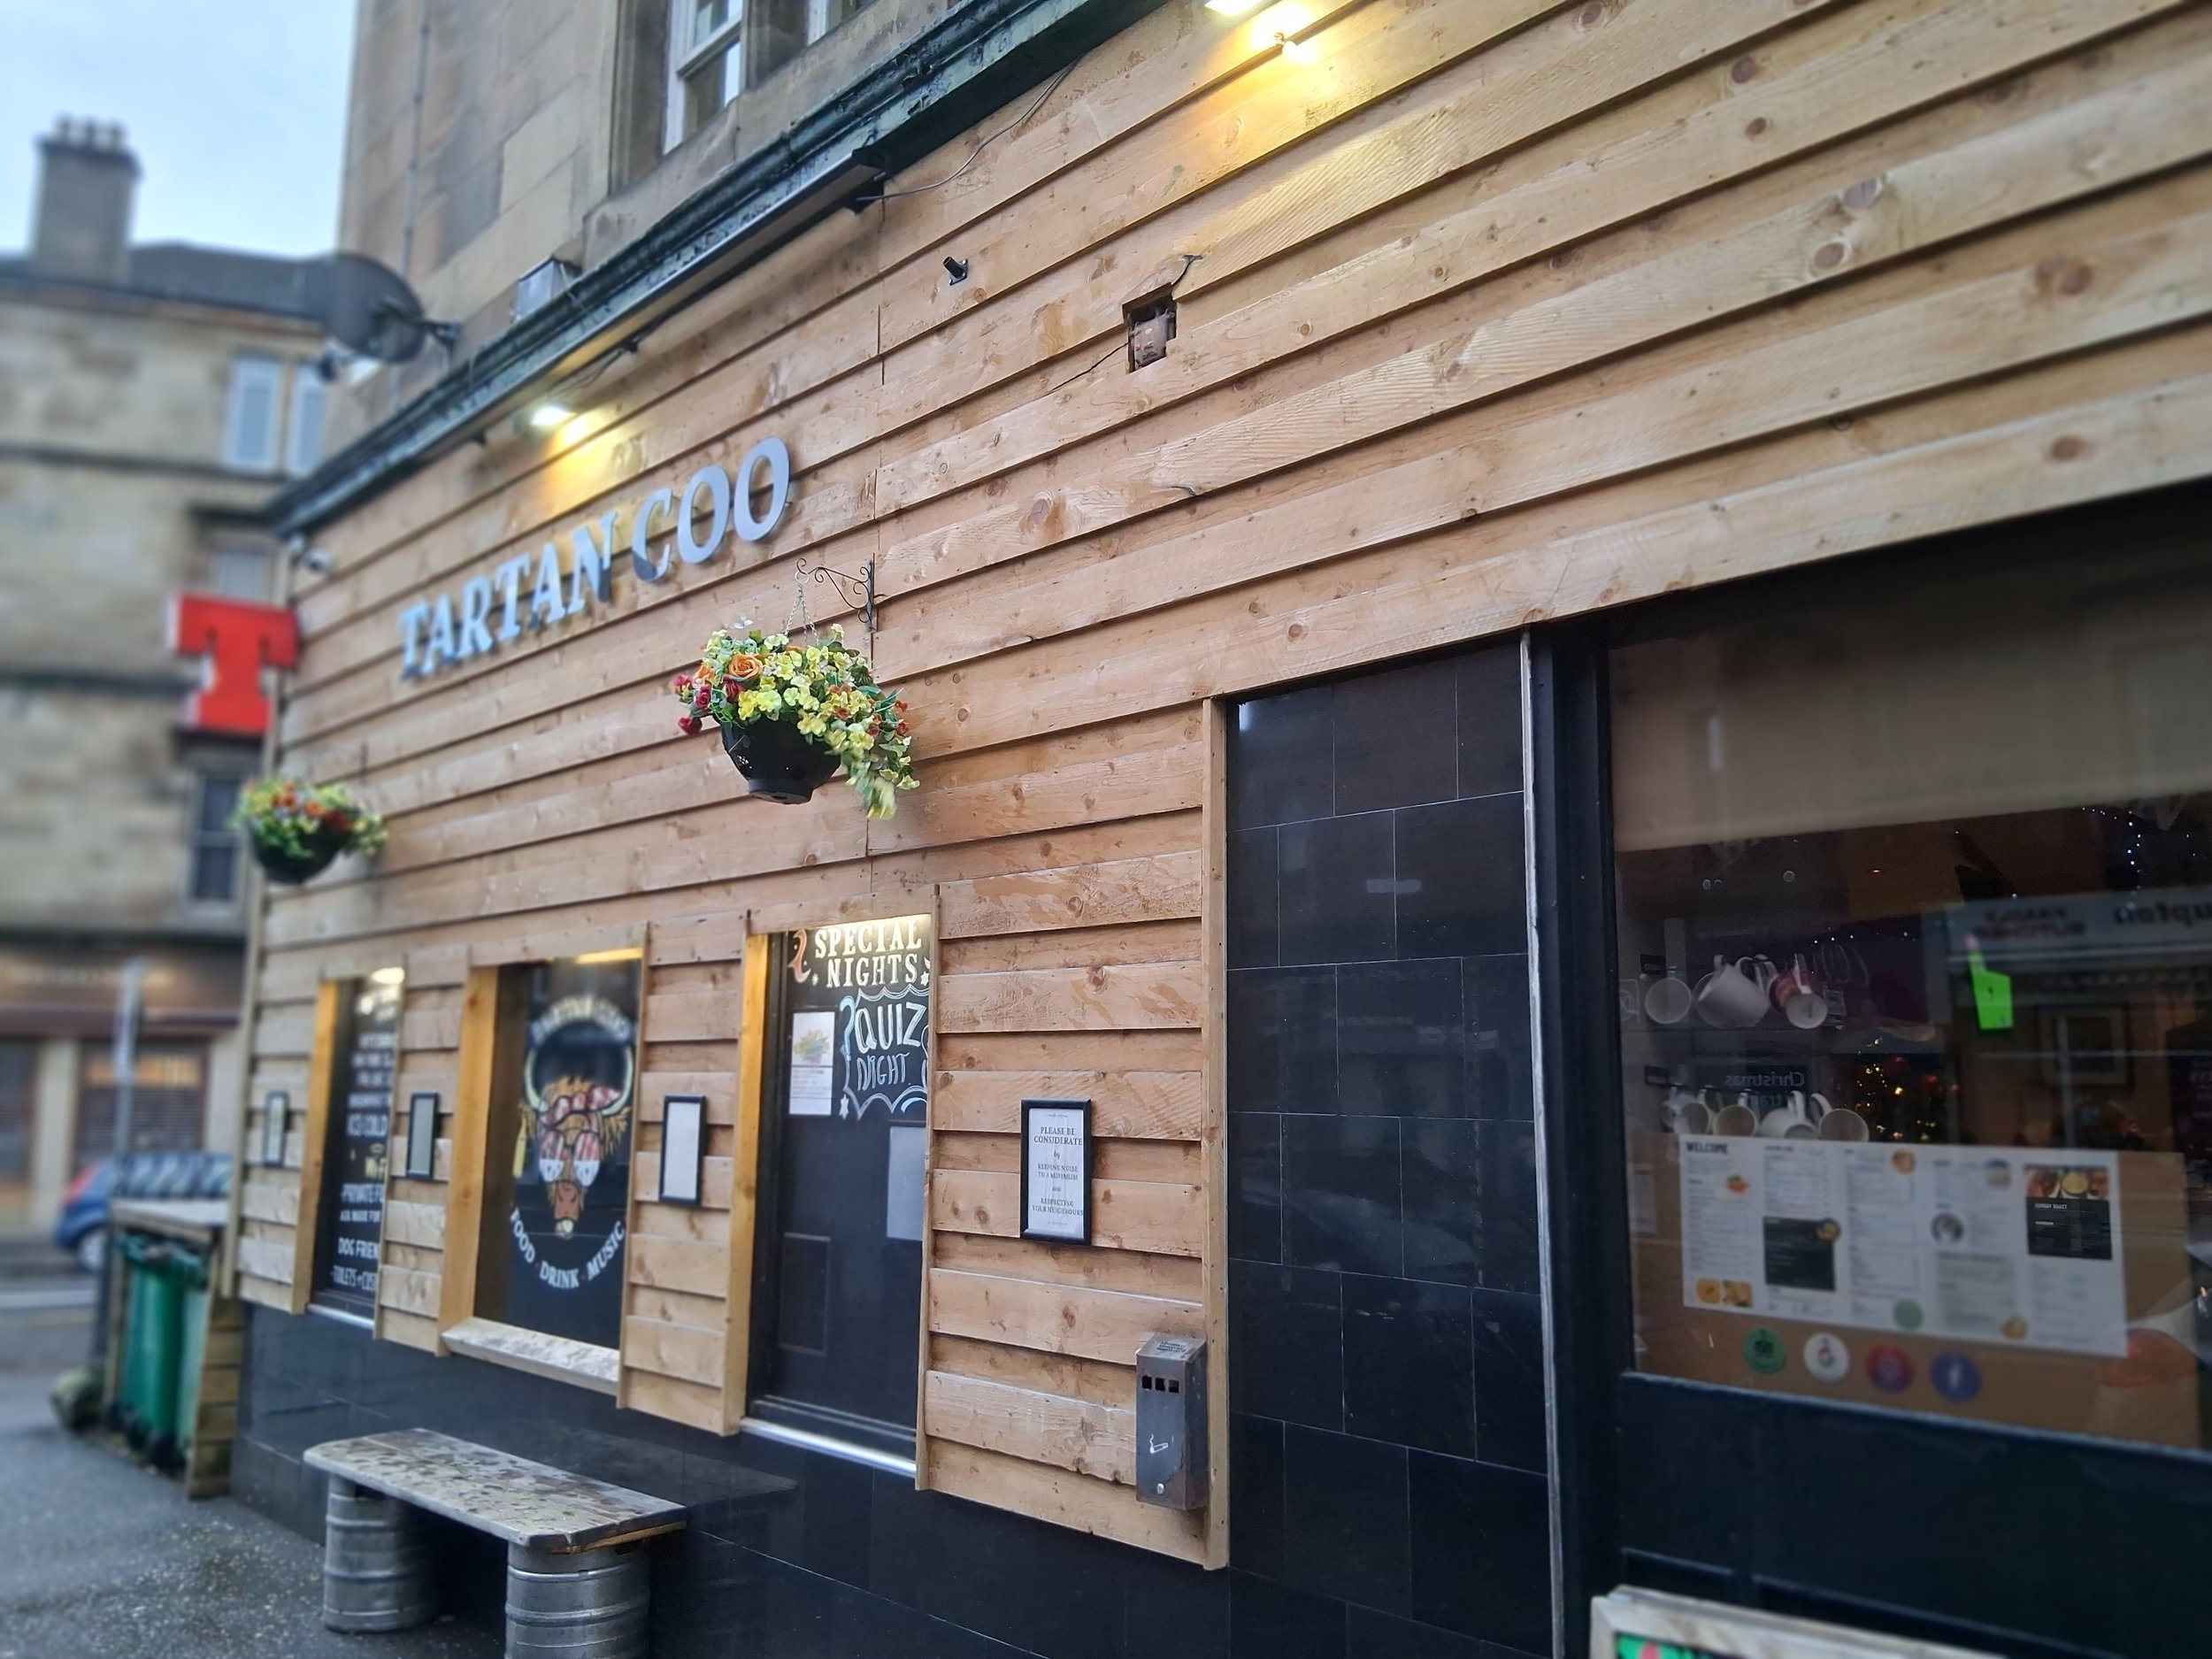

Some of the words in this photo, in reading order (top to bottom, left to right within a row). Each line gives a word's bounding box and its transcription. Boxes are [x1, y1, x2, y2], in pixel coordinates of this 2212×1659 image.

[396, 511, 618, 681] TARTAN
[631, 435, 790, 584] COO
[176, 595, 297, 733] T
[814, 918, 923, 959] SPECIAL
[826, 953, 918, 988] NIGHTS
[855, 1001, 927, 1055] QUIZ
[856, 1052, 910, 1091] NIGHT
[1033, 1135, 1083, 1146] CONSIDERATE
[1041, 1126, 1064, 1136] PLEASE
[1066, 1127, 1076, 1136] BE
[338, 1237, 356, 1256] DOG
[510, 1206, 536, 1264] FOOD
[539, 1260, 581, 1291] DRINK
[587, 1220, 626, 1283] MUSIC
